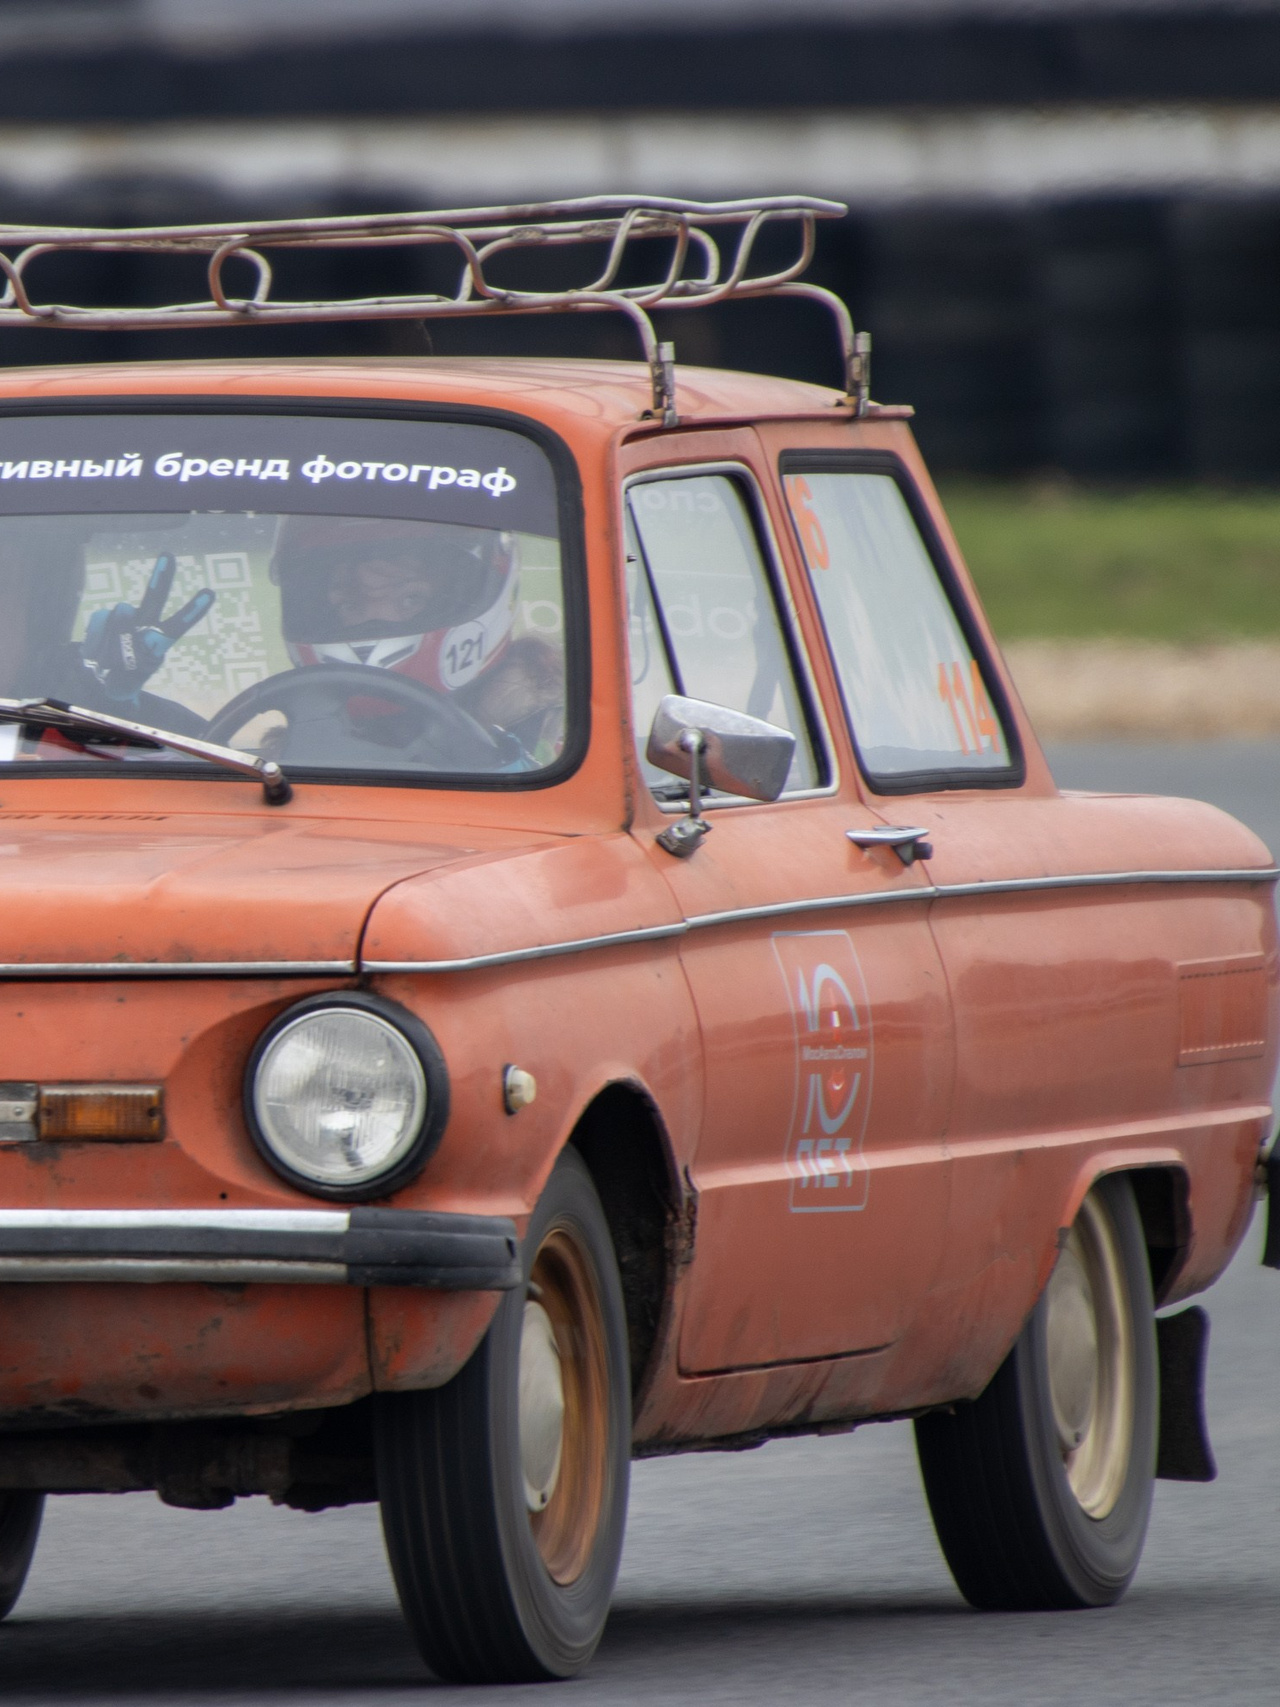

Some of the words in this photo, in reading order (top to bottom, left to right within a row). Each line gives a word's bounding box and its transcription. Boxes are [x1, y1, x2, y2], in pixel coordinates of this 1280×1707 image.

[154, 451, 290, 483] бренд
[301, 454, 518, 498] фотограф
[446, 631, 484, 674] 121
[937, 659, 1002, 756] 114
